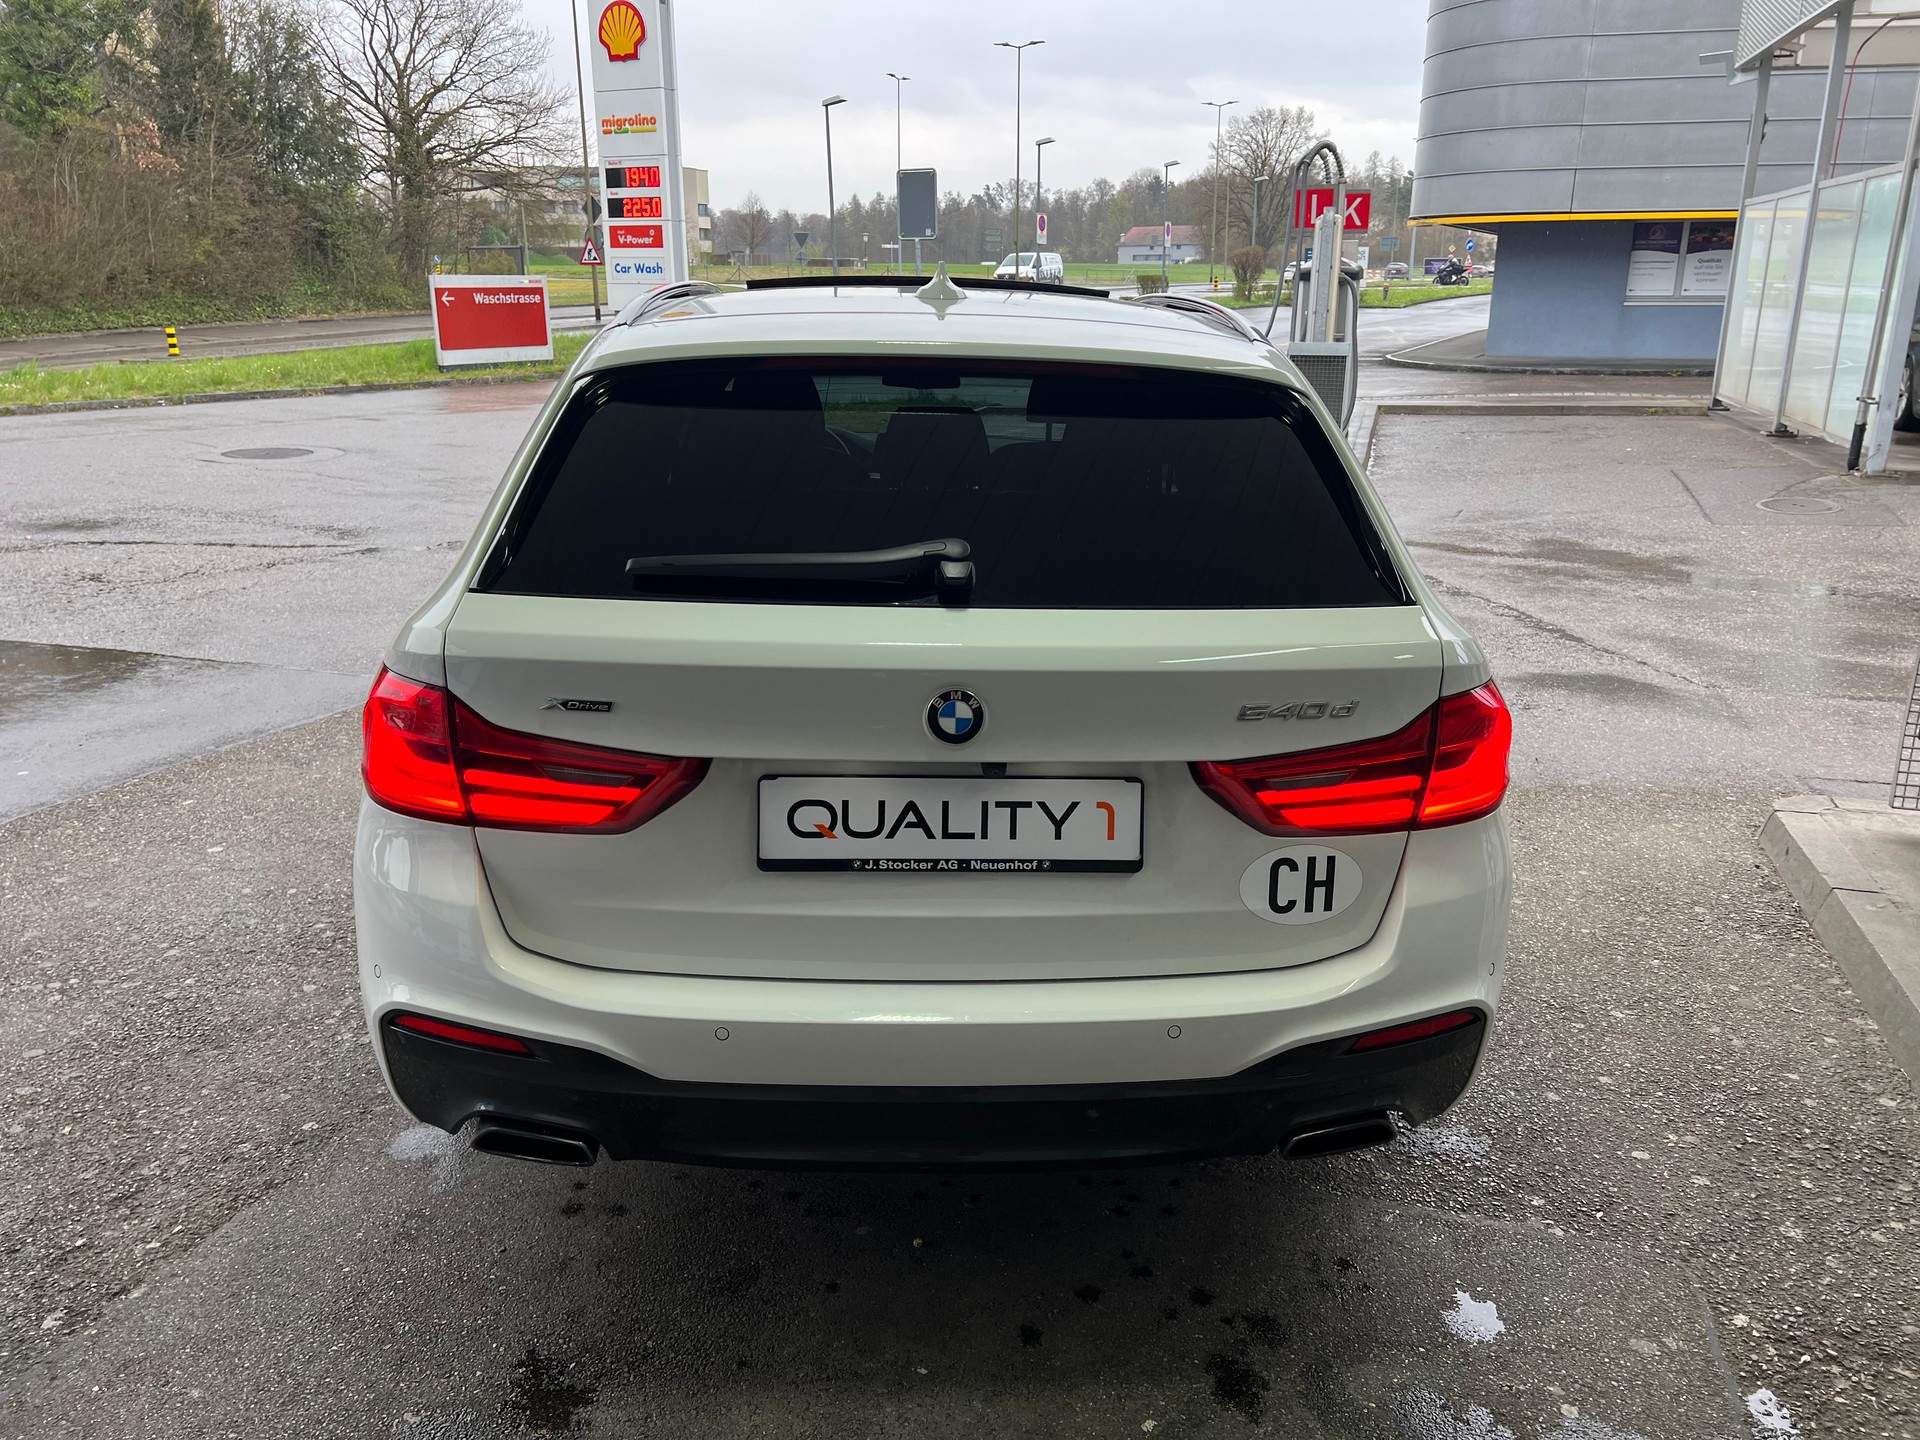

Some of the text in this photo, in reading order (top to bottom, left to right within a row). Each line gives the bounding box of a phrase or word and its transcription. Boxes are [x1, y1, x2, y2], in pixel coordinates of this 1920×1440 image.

[601, 113, 657, 130] migrolino
[617, 234, 654, 244] V-Power
[614, 261, 663, 274] Car Wash
[473, 292, 541, 305] Waschstrasse
[932, 690, 980, 710] BMW
[786, 798, 1115, 841] QUALITY 1
[878, 859, 933, 870] Stocker
[937, 859, 958, 870] AG
[970, 859, 1039, 870] Neuenhof
[1268, 855, 1336, 915] CH
